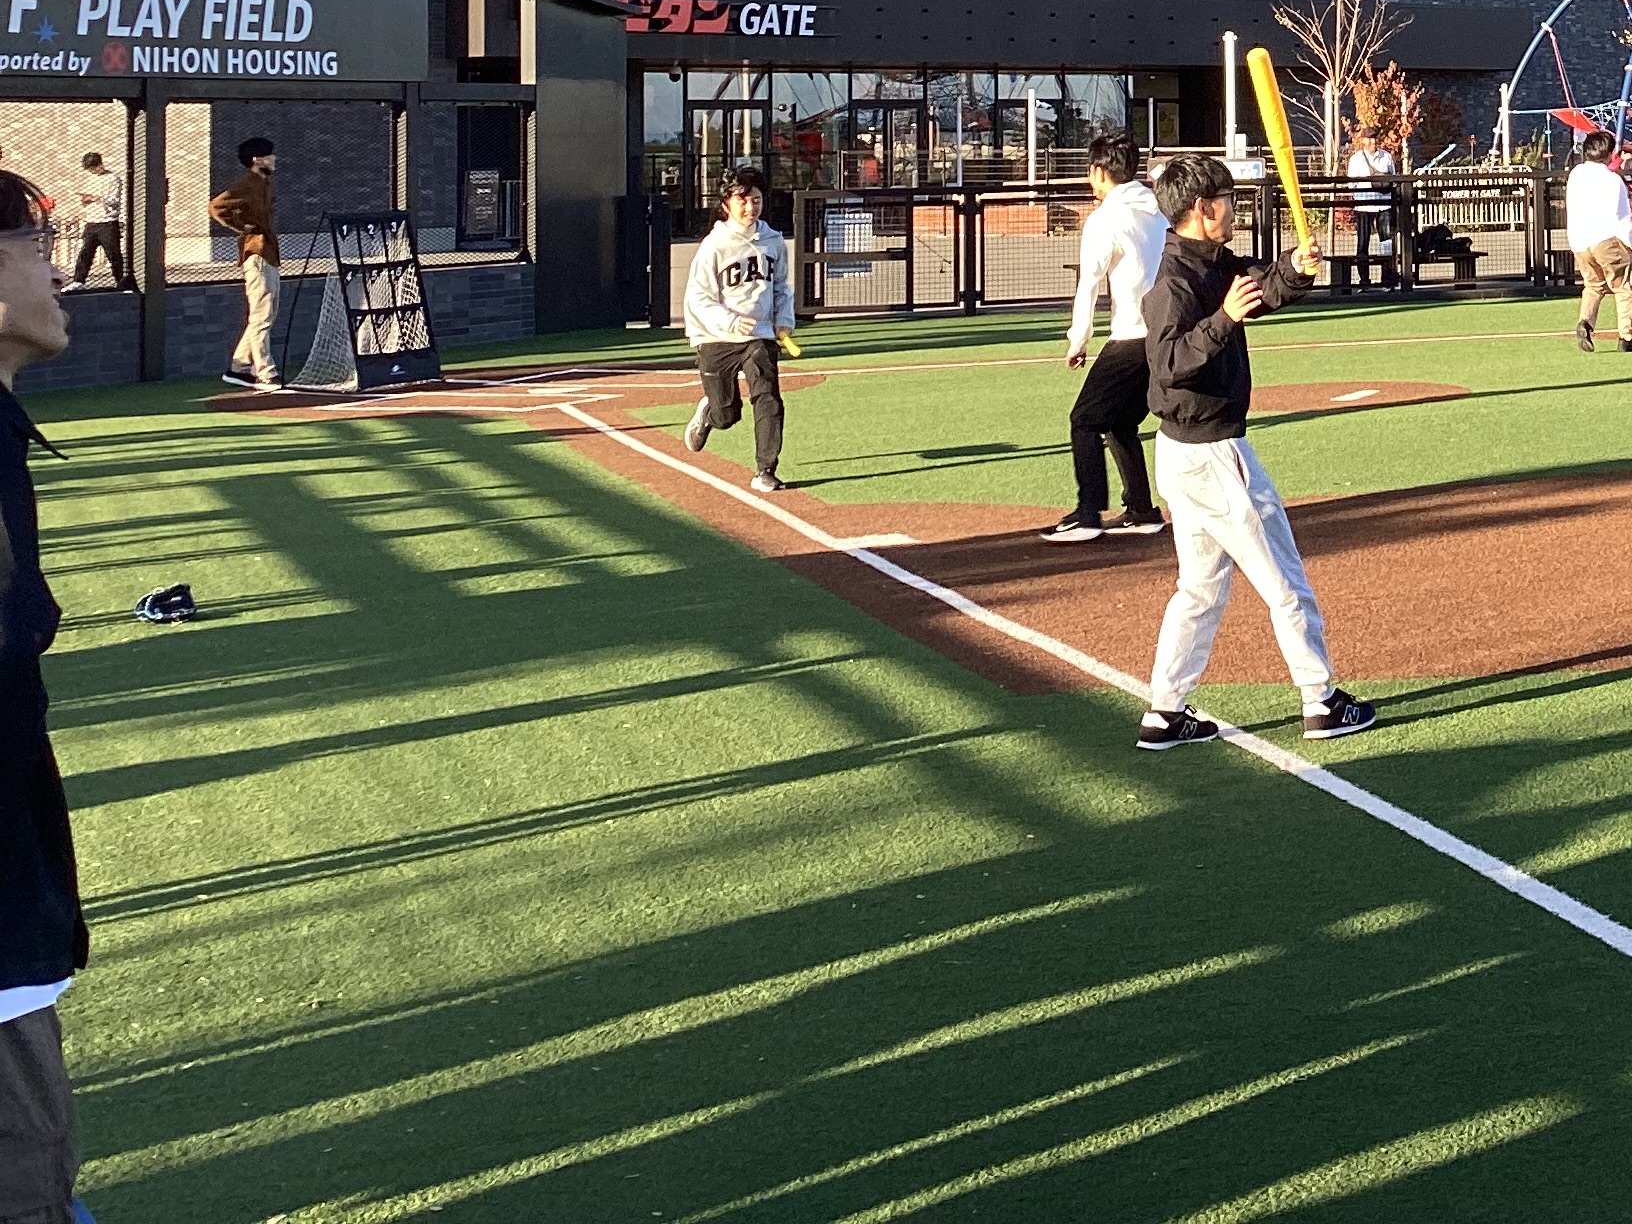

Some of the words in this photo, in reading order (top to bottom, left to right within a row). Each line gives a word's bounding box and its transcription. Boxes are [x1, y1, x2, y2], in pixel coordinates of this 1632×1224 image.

[739, 2, 817, 36] GATE
[0, 50, 64, 74] ported
[68, 50, 91, 76] by
[132, 46, 219, 75] NIHON
[226, 48, 338, 76] HOUSING
[342, 224, 347, 236] 1
[367, 224, 375, 235] 2
[390, 221, 397, 233] 3
[1342, 704, 1360, 724] N
[1178, 720, 1198, 740] N
